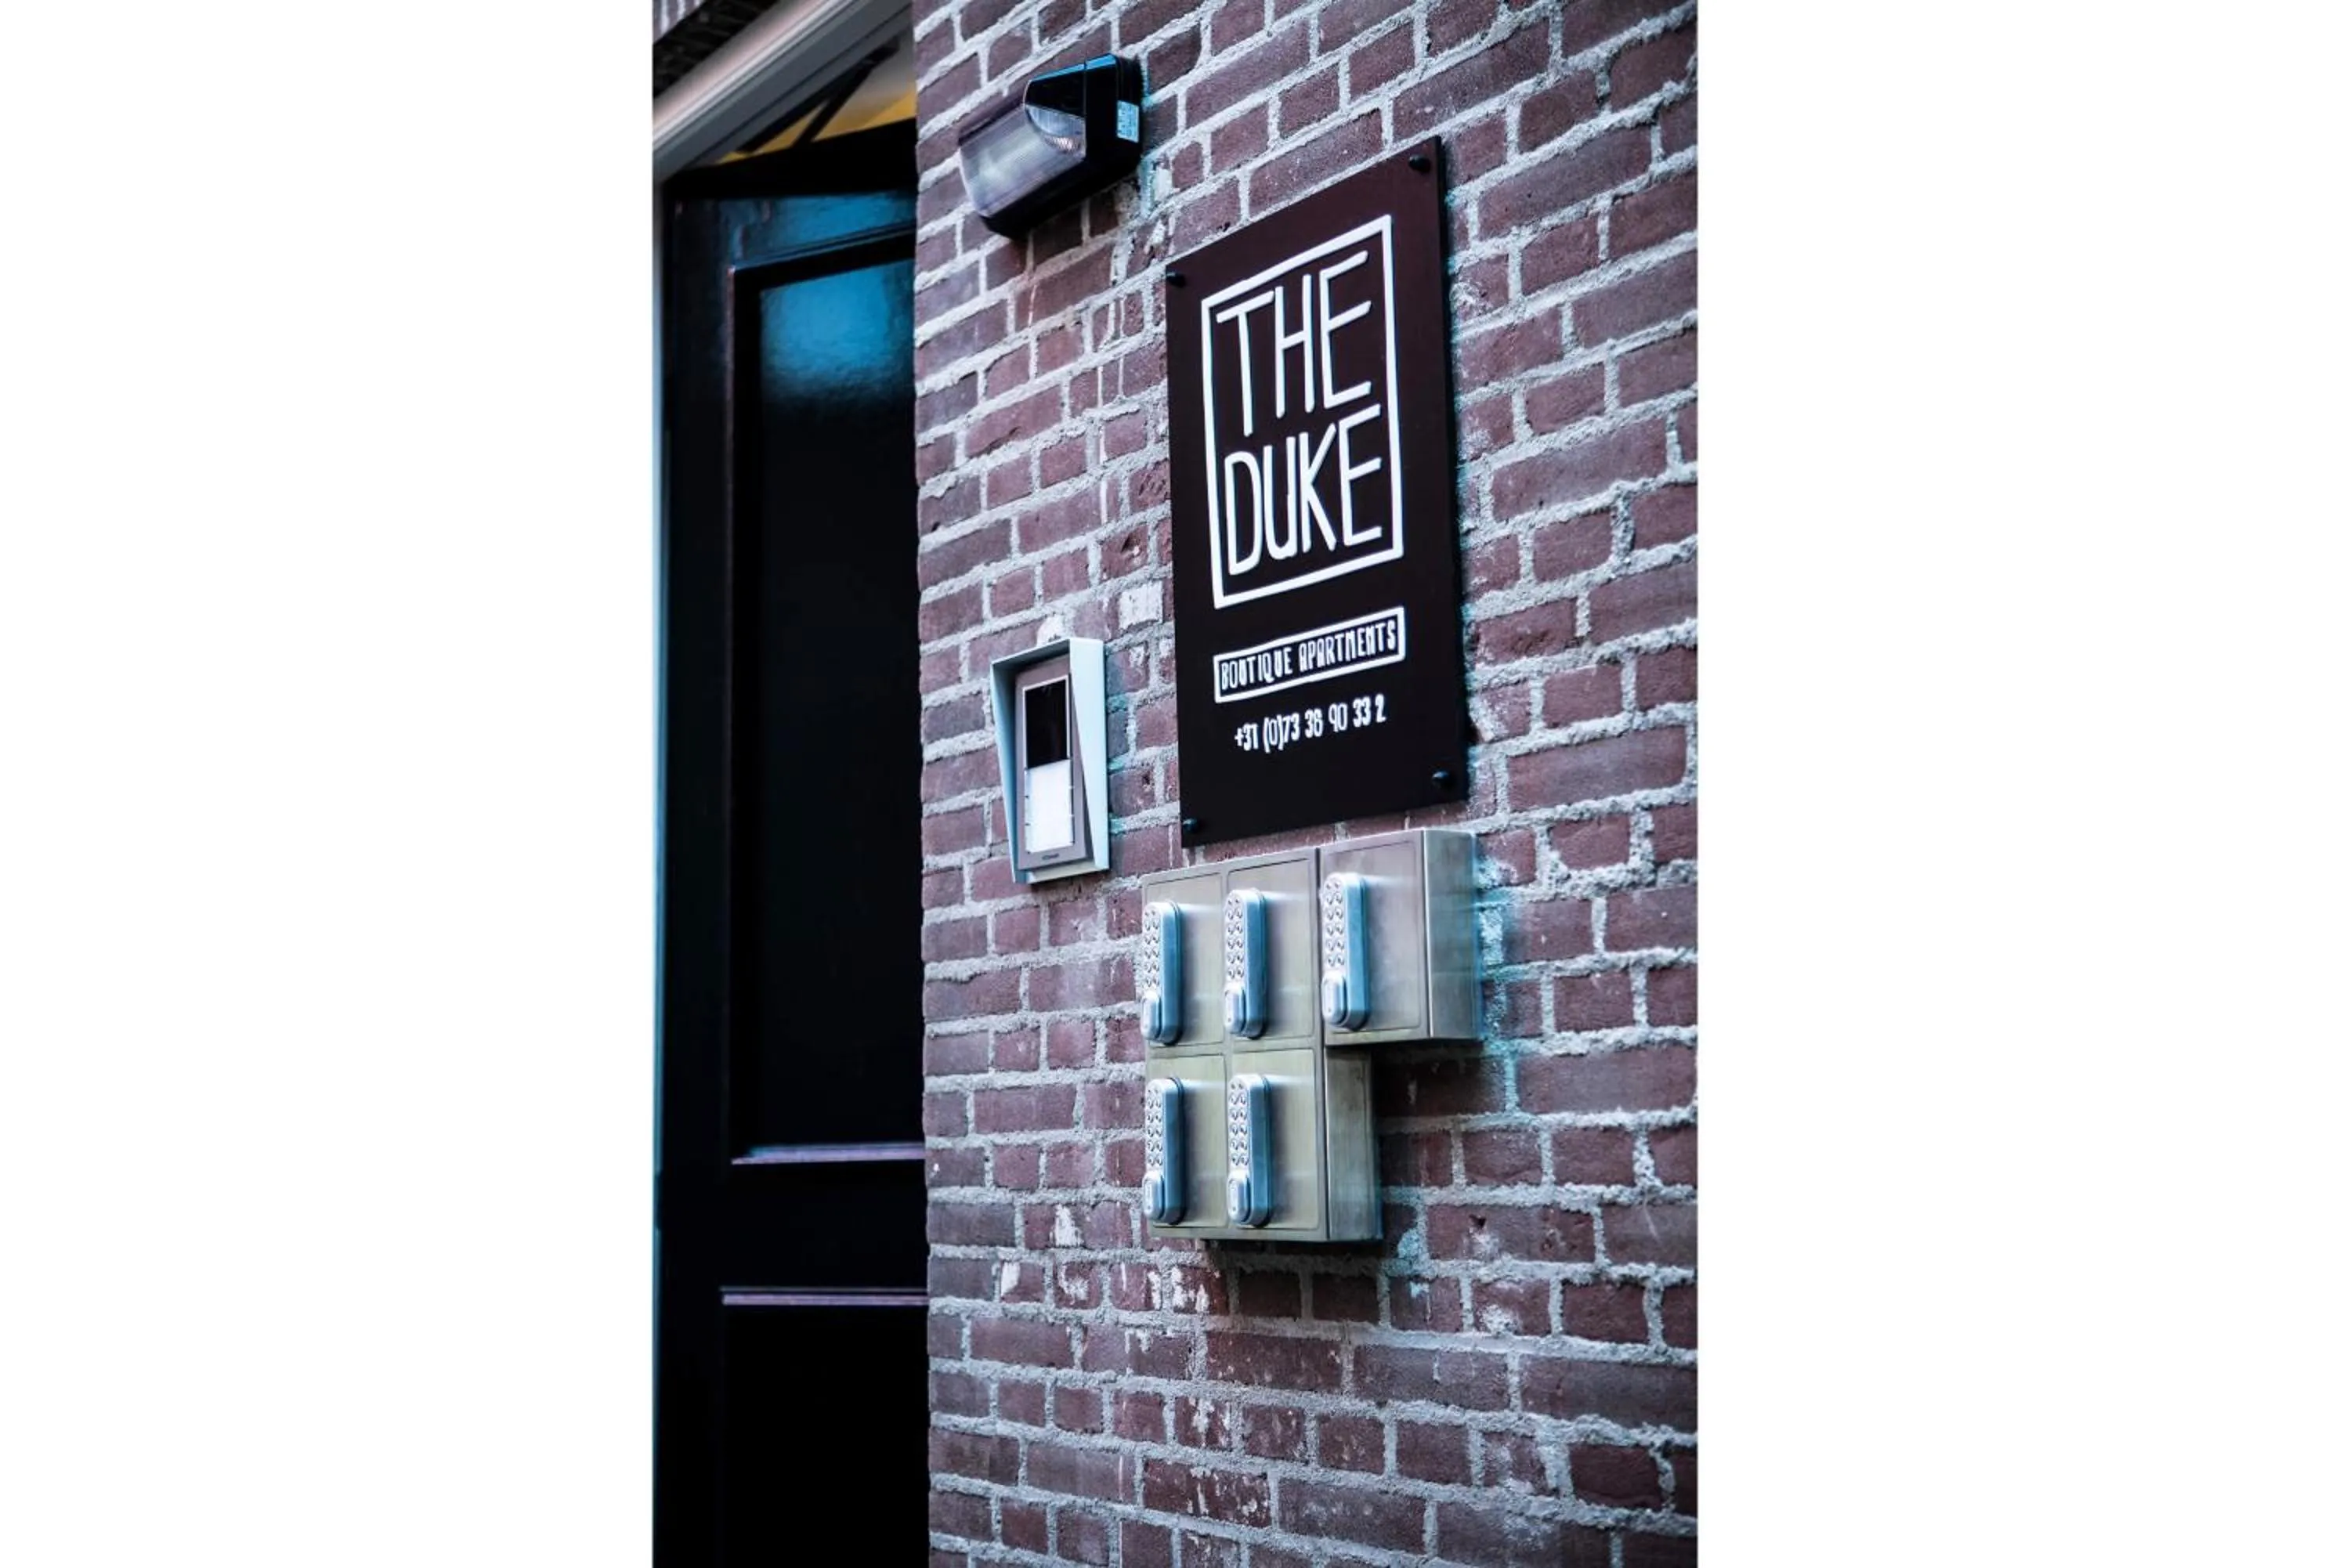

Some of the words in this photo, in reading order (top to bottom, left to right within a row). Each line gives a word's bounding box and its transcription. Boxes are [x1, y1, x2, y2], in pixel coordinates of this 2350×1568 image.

[1216, 250, 1372, 437] THE
[1224, 403, 1382, 576] DUKE
[1221, 647, 1292, 691] BOUTIQUE
[1298, 620, 1397, 673] APARTMENTS
[1235, 723, 1259, 751] +31
[1263, 714, 1300, 753] (0)73
[1328, 703, 1348, 732] 90
[1352, 696, 1372, 728] 33
[1375, 693, 1386, 723] 2
